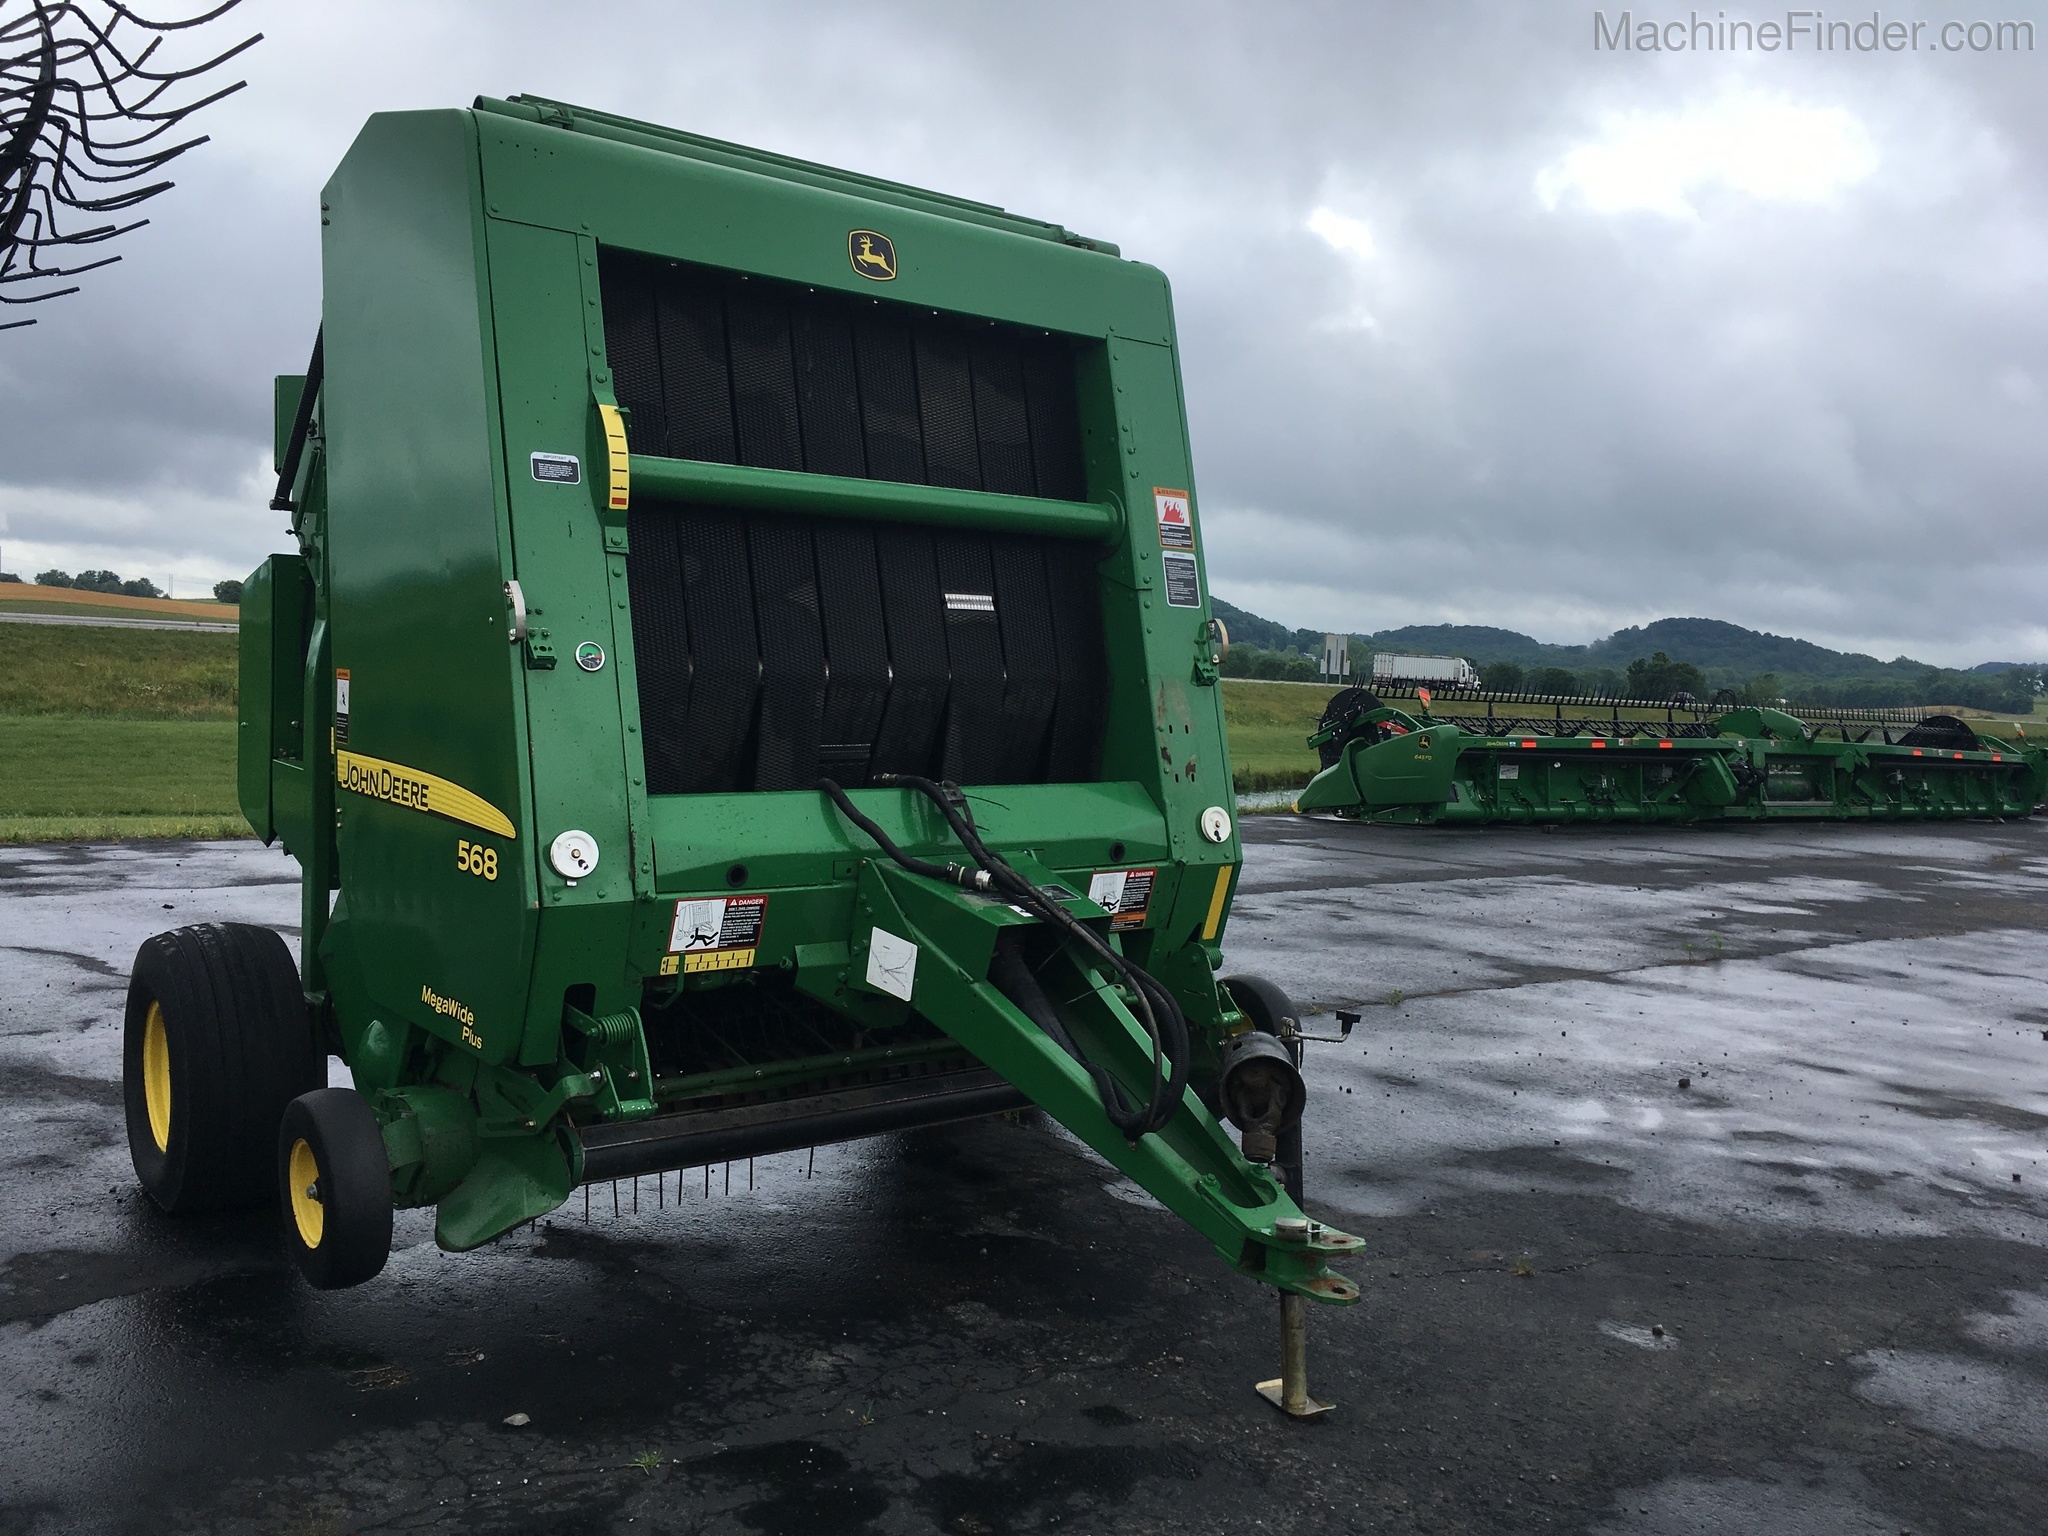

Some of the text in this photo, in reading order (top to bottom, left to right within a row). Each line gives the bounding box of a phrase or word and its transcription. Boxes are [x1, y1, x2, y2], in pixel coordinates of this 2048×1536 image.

[342, 760, 430, 809] JOHN DEERE
[457, 839, 498, 881] 568
[738, 898, 764, 906] DANGER
[421, 984, 474, 1026] MegaWide
[461, 1026, 483, 1049] Plus
